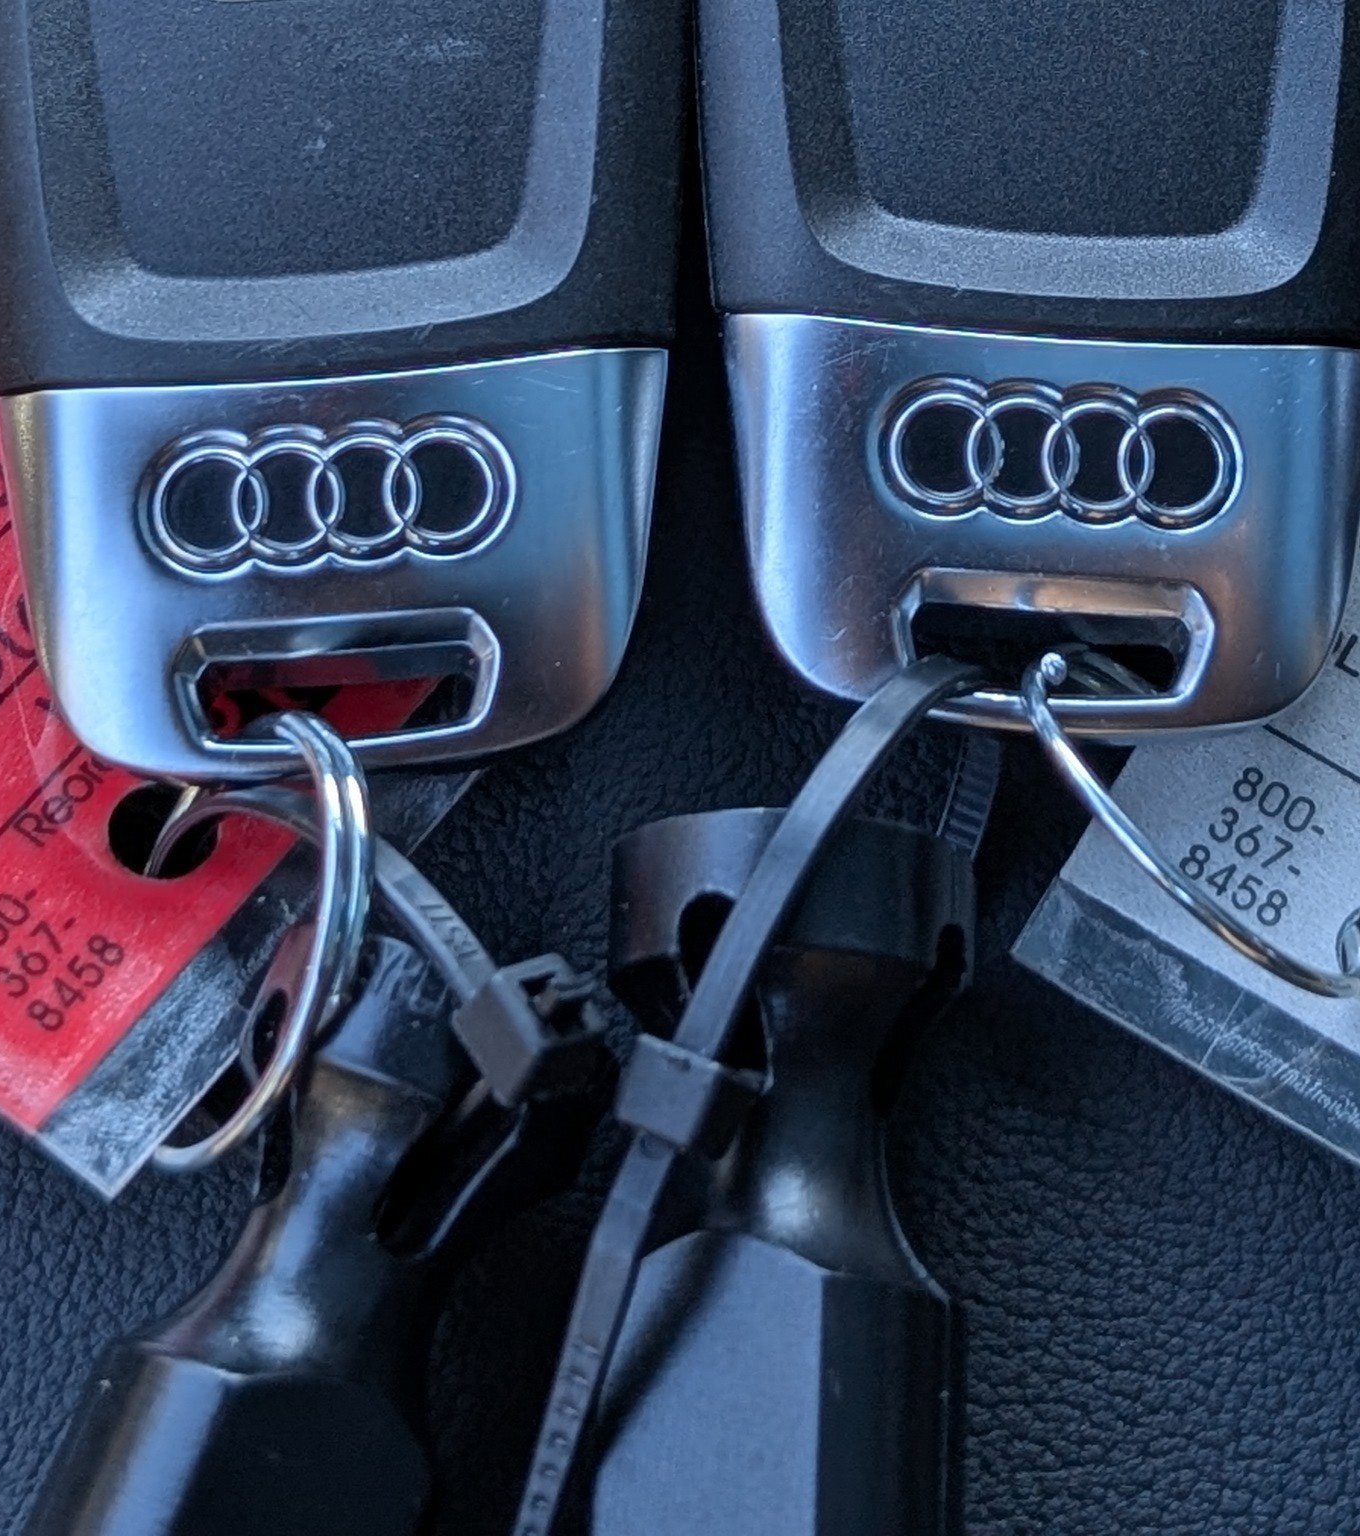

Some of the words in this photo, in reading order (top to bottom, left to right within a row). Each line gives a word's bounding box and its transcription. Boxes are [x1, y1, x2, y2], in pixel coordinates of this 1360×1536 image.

[1232, 766, 1326, 837] 800-
[1208, 806, 1301, 878] 367-
[1179, 843, 1289, 928] 8458
[27, 934, 126, 1033] 8458
